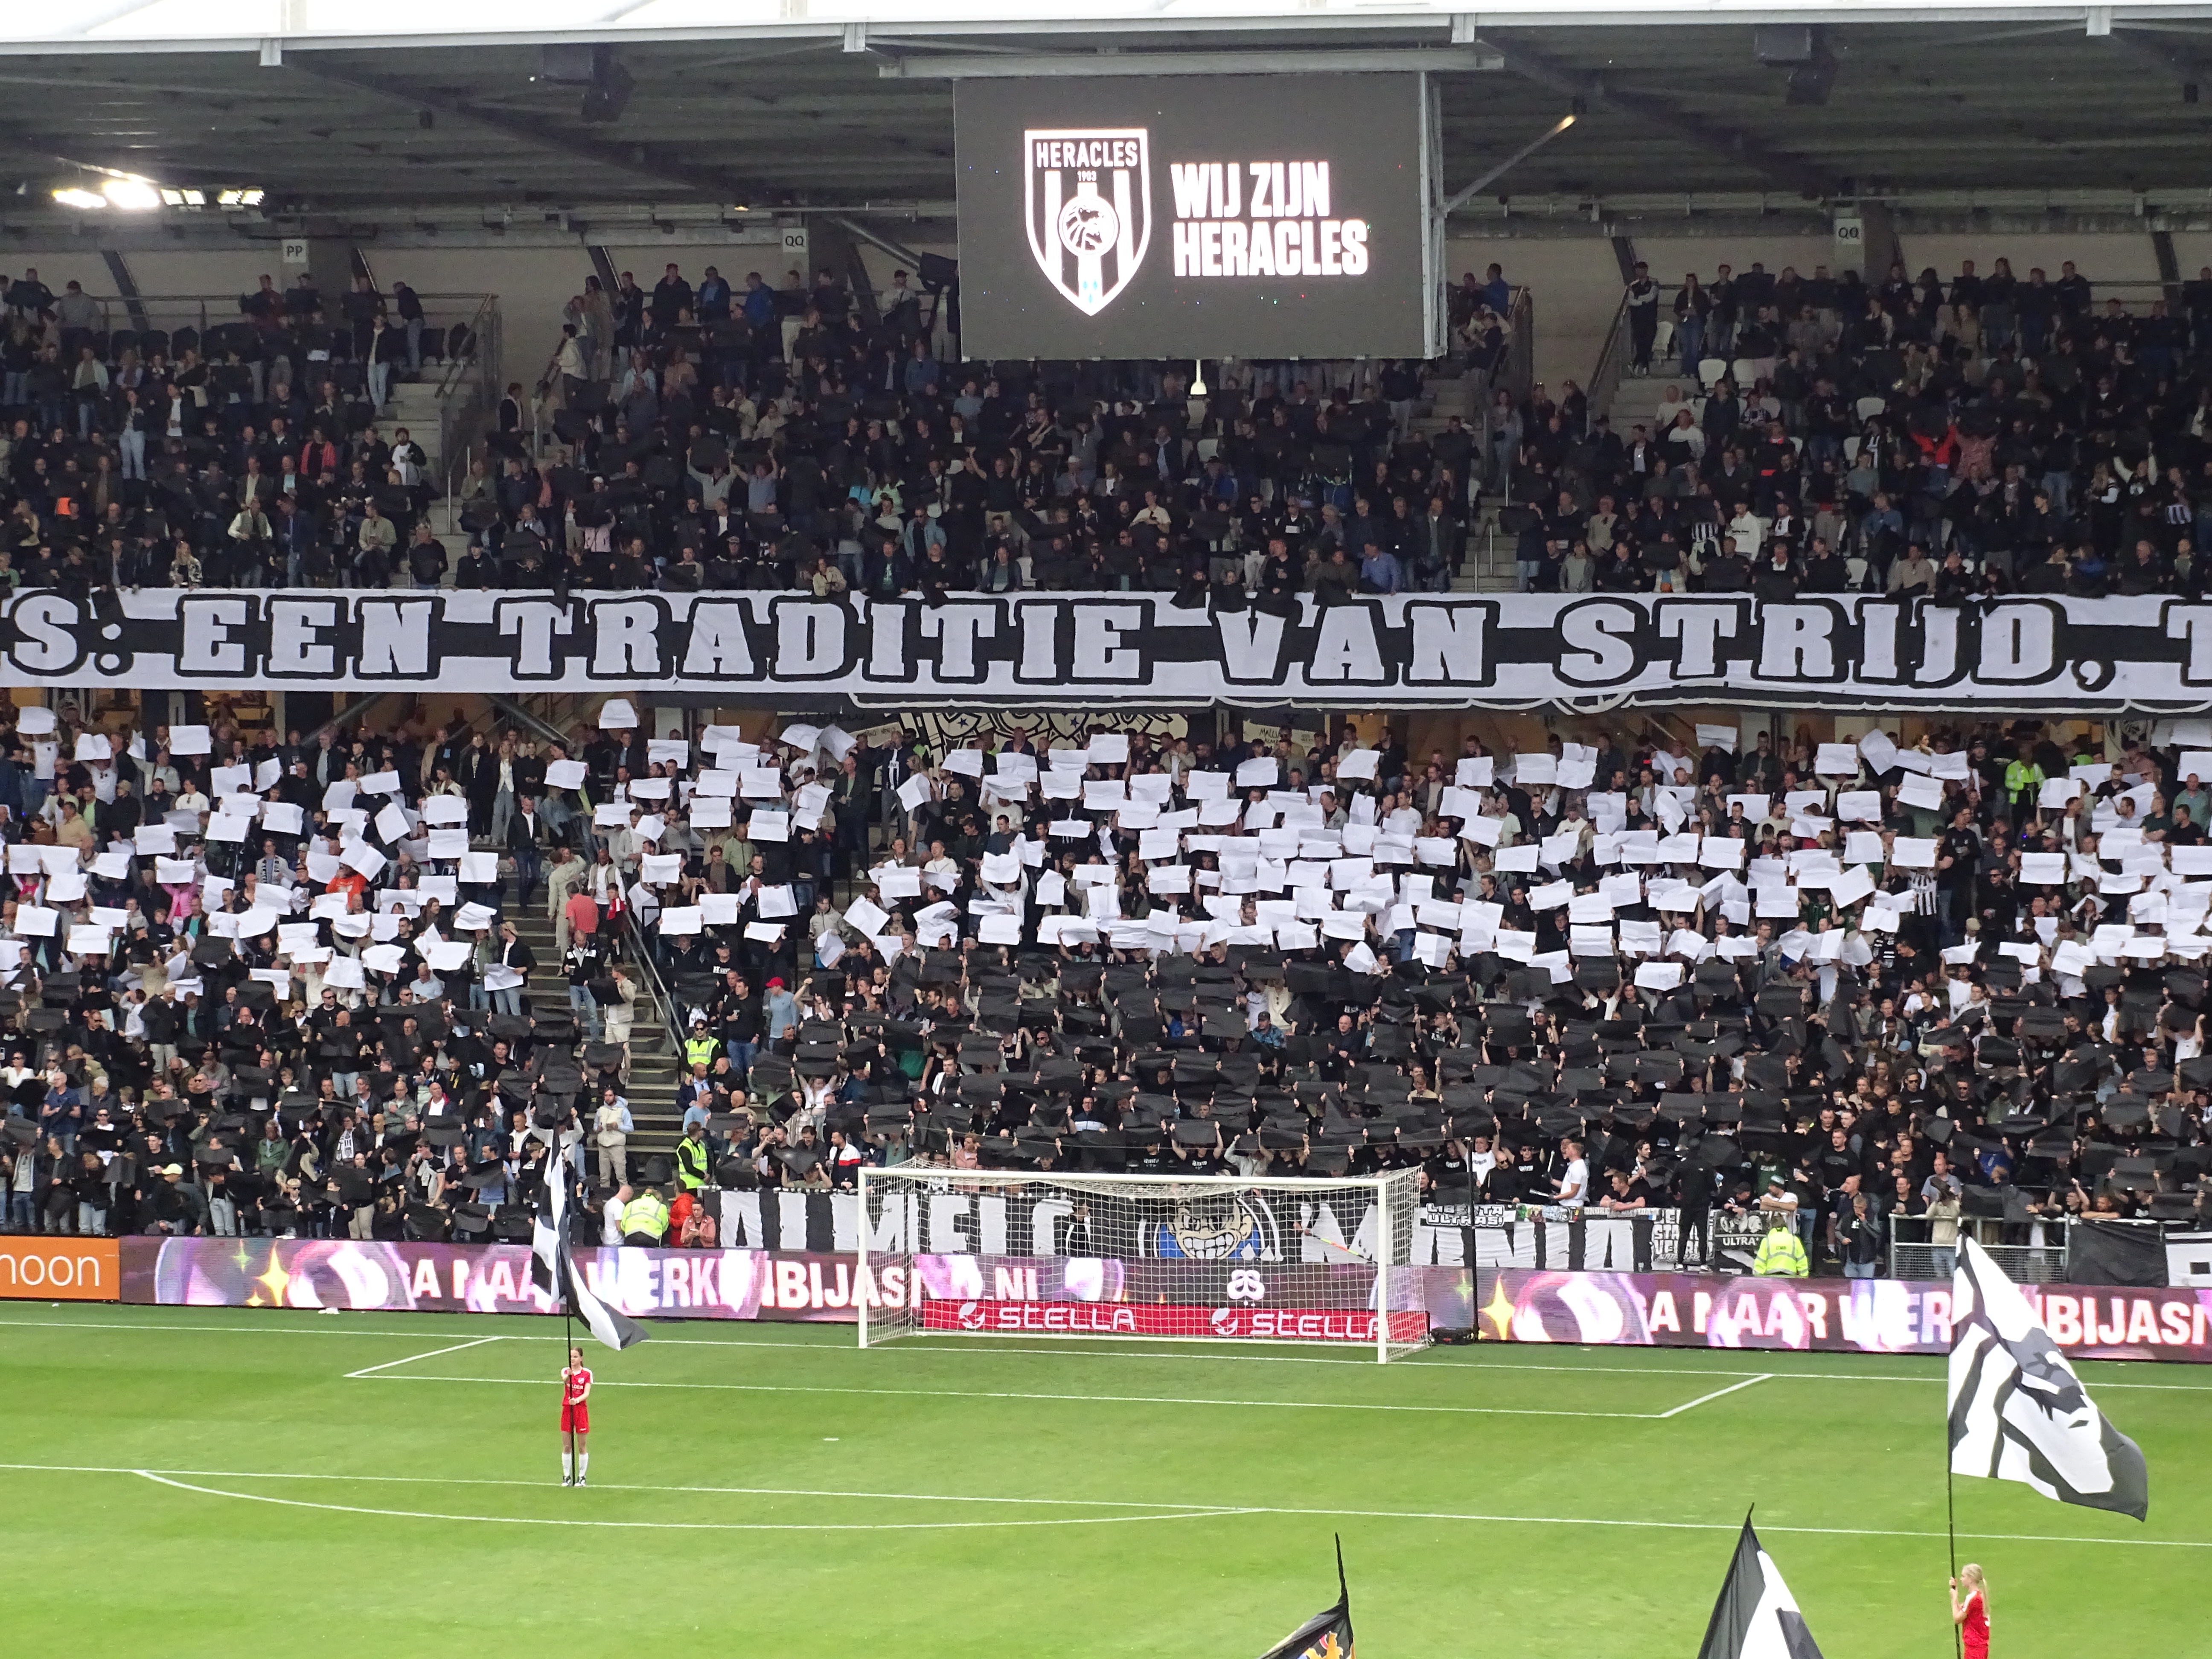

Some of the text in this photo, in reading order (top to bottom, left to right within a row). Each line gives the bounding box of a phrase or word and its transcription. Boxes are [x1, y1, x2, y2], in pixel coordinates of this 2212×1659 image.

[1036, 141, 1138, 168] HERACLES
[1077, 171, 1097, 181] 1903
[1170, 161, 1330, 218] WIJ ZIJN
[786, 236, 804, 247] QQ
[1173, 220, 1368, 276] HERACLES
[286, 246, 303, 257] PP
[179, 597, 436, 675] EEN
[496, 598, 1144, 680] TRADITIE
[1213, 604, 1490, 683] VAN
[1723, 1237, 1759, 1246] ULTRA
